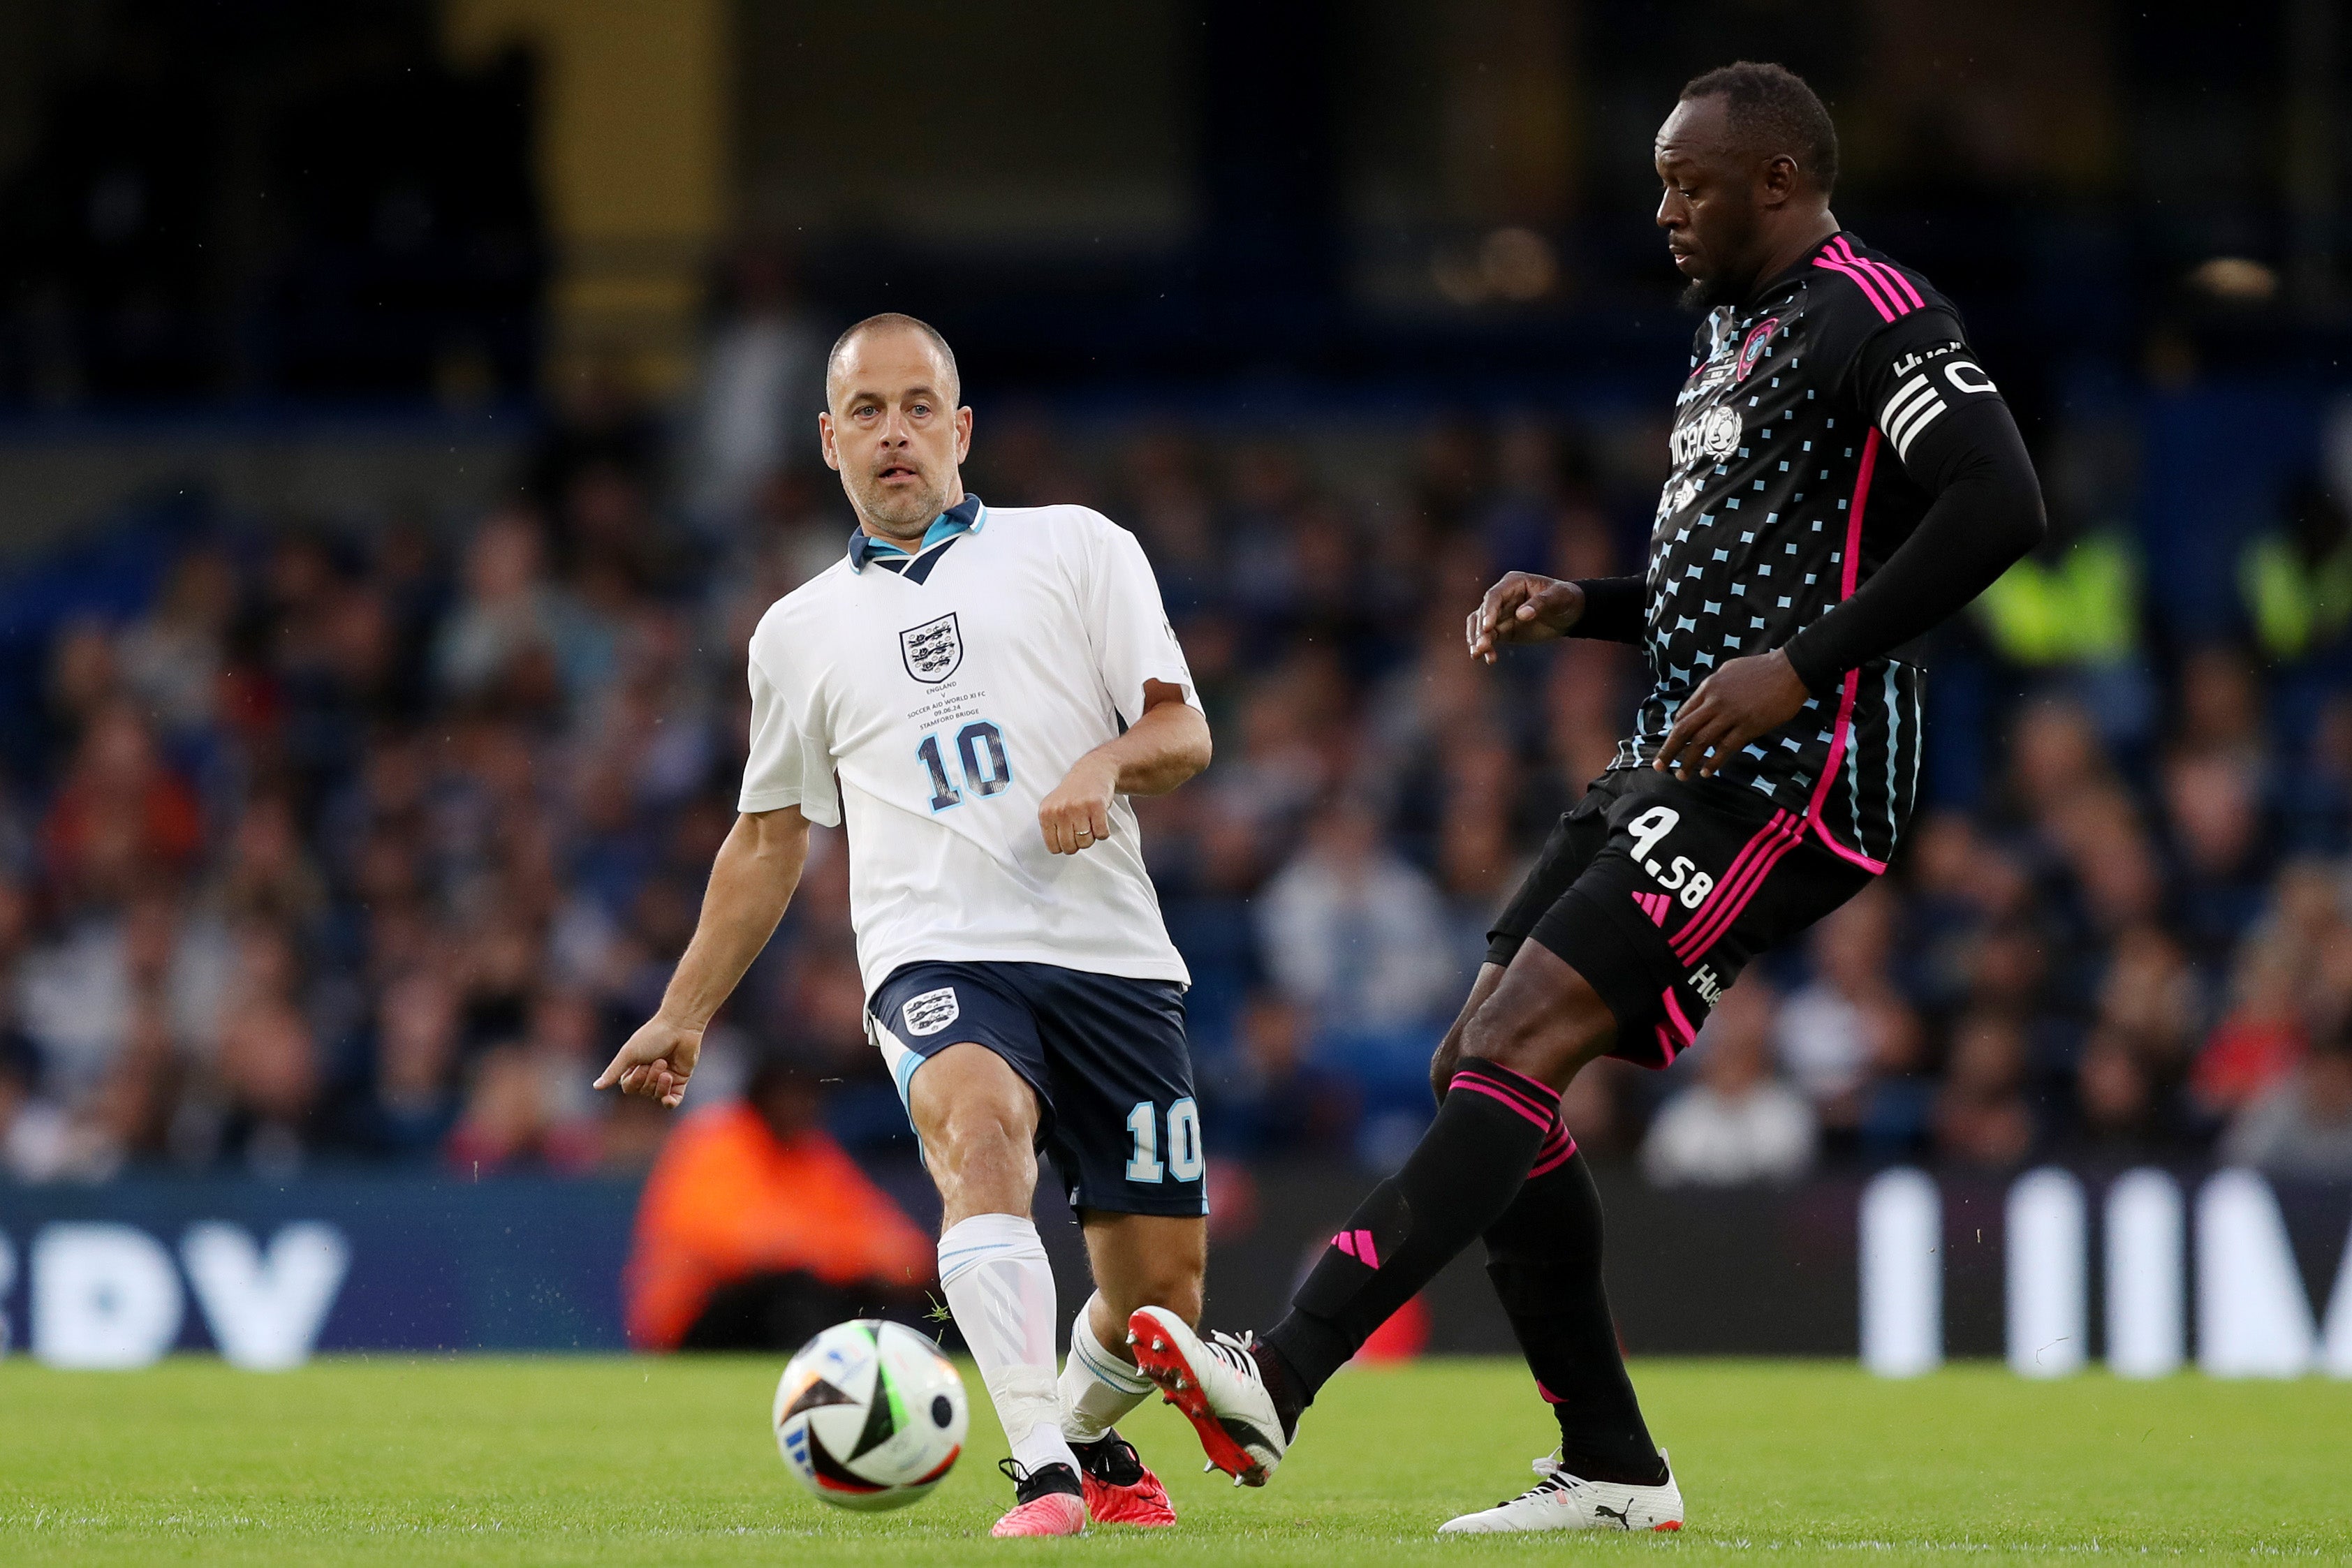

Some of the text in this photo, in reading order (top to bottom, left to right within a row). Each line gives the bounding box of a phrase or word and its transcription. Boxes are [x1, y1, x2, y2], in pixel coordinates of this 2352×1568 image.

[907, 705, 931, 719] SOCCER
[932, 701, 943, 709] AID
[944, 695, 969, 704] WORLD
[926, 681, 957, 695] ENGLAND
[919, 708, 980, 730] STAMFORD BRIDGE
[934, 704, 961, 717] 09.06.24
[915, 718, 1014, 815] 10
[1628, 806, 1714, 908] 9.58
[1688, 963, 1722, 1007] Hue
[1126, 1096, 1203, 1183] 10
[0, 1220, 349, 1372] DV
